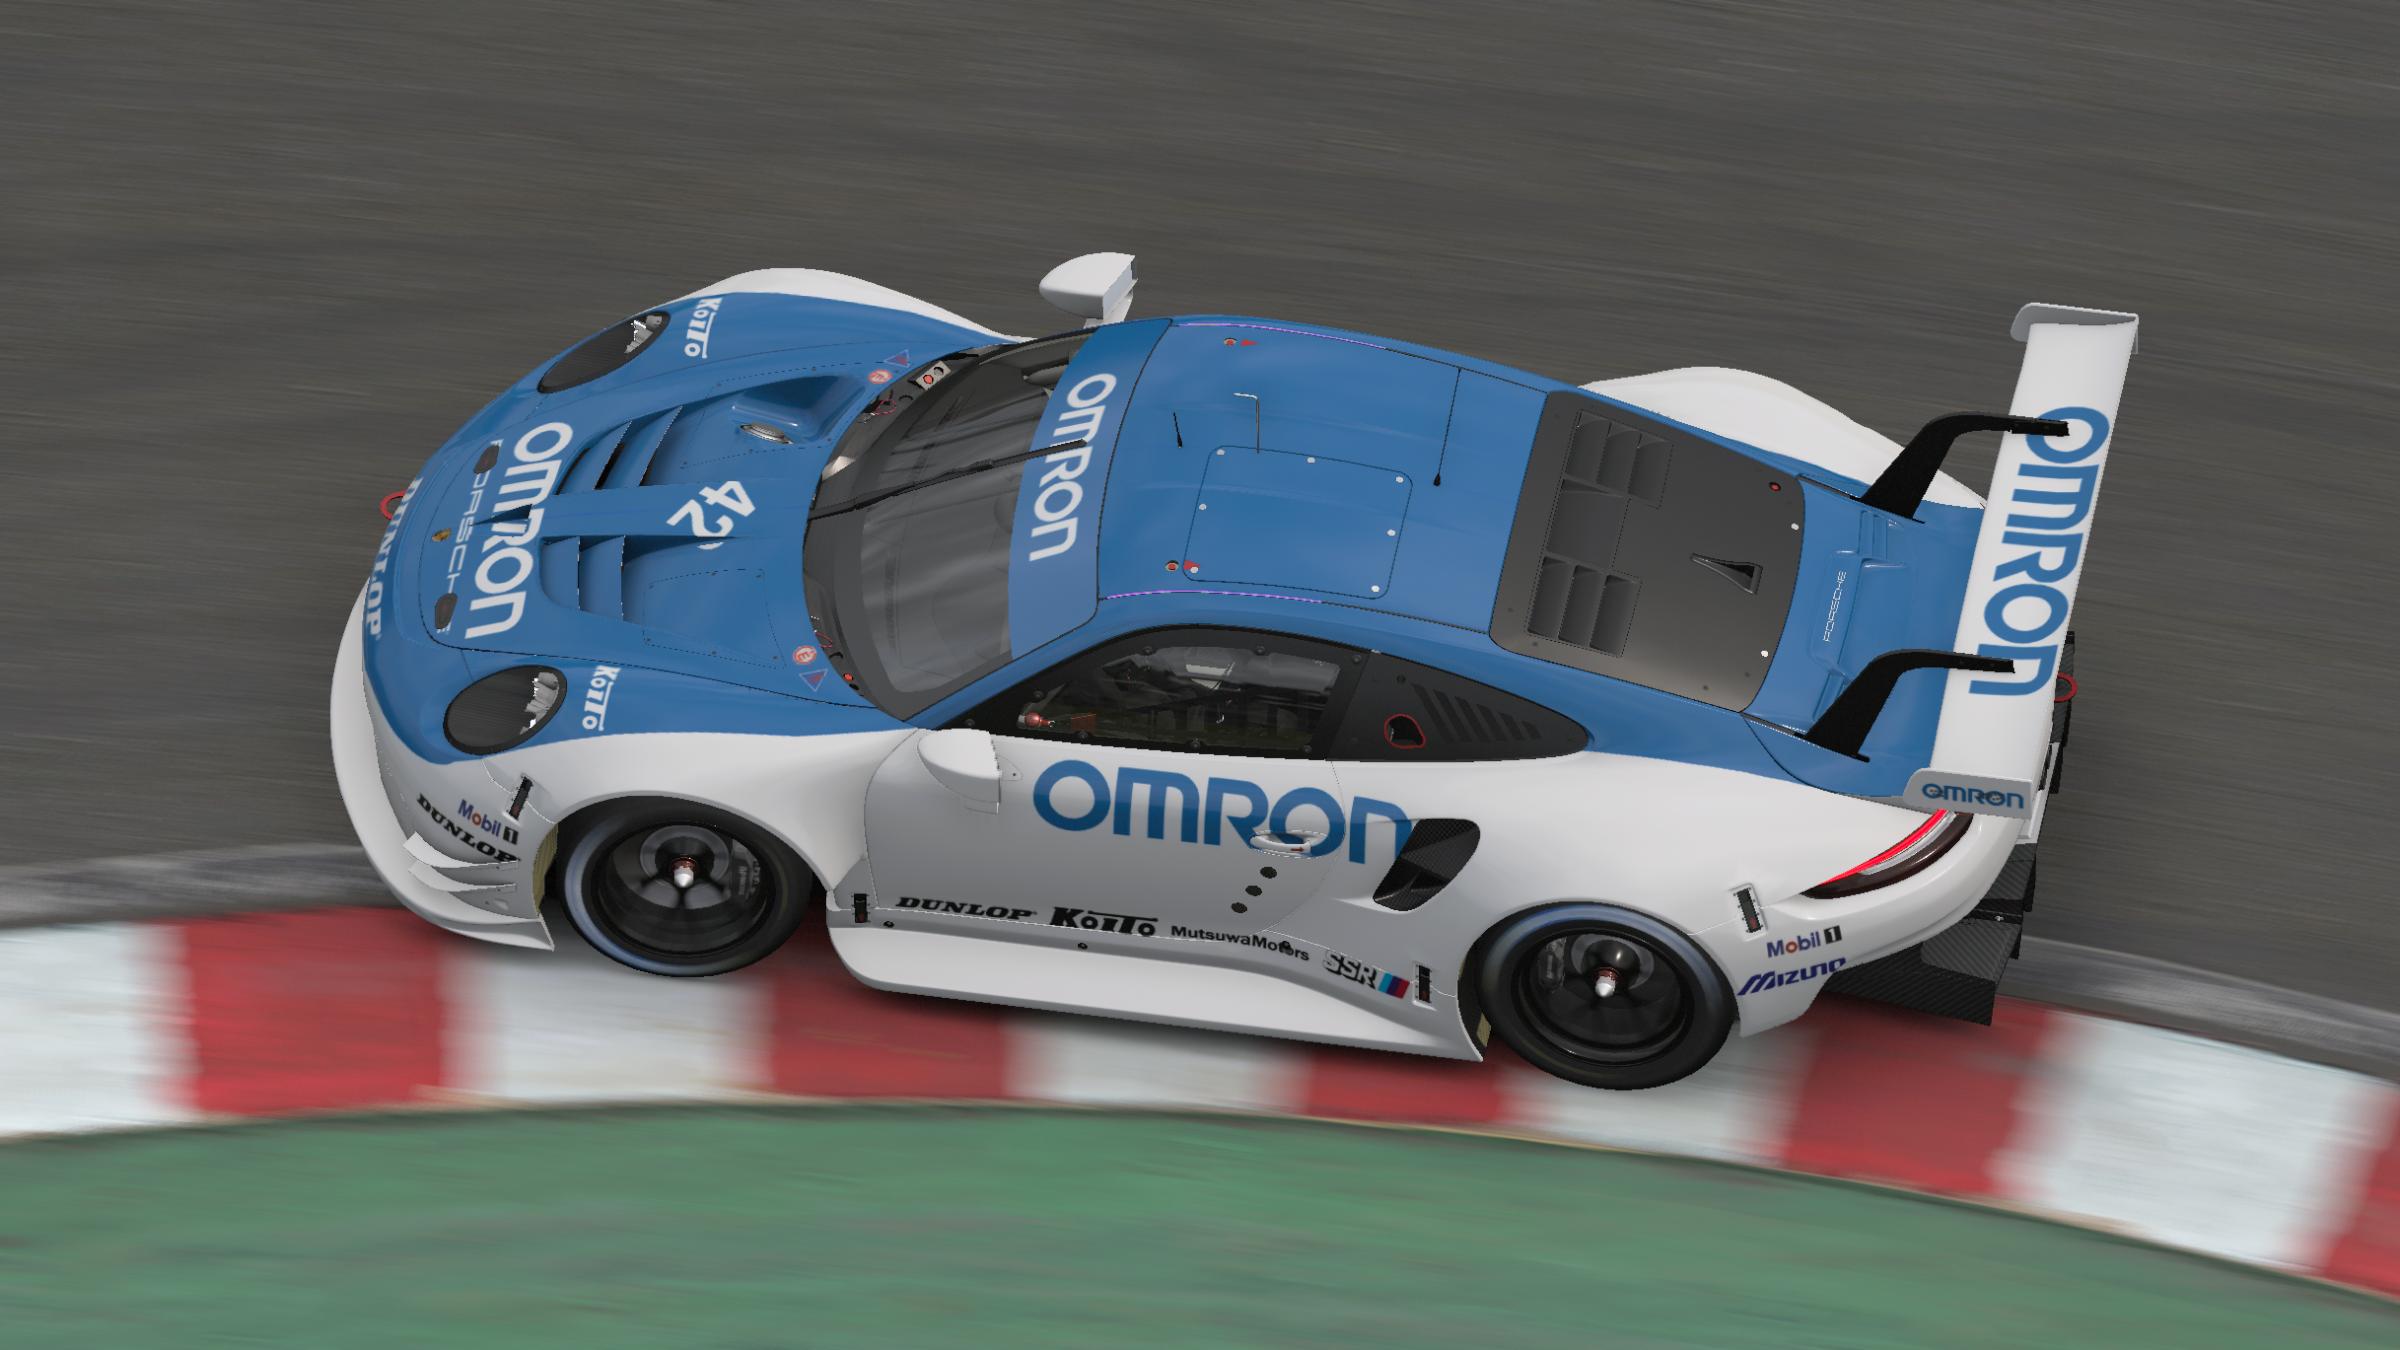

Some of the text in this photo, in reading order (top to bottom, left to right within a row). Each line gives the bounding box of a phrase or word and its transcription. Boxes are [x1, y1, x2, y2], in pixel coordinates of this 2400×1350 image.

[666, 480, 755, 550] 42
[1822, 570, 1847, 642] PORSCHE
[417, 793, 518, 862] DUNLOP
[458, 799, 501, 837] Mobil
[896, 897, 1034, 920] DUNLOP
[1767, 931, 1821, 958] Mobil
[1323, 950, 1380, 990] SSR
